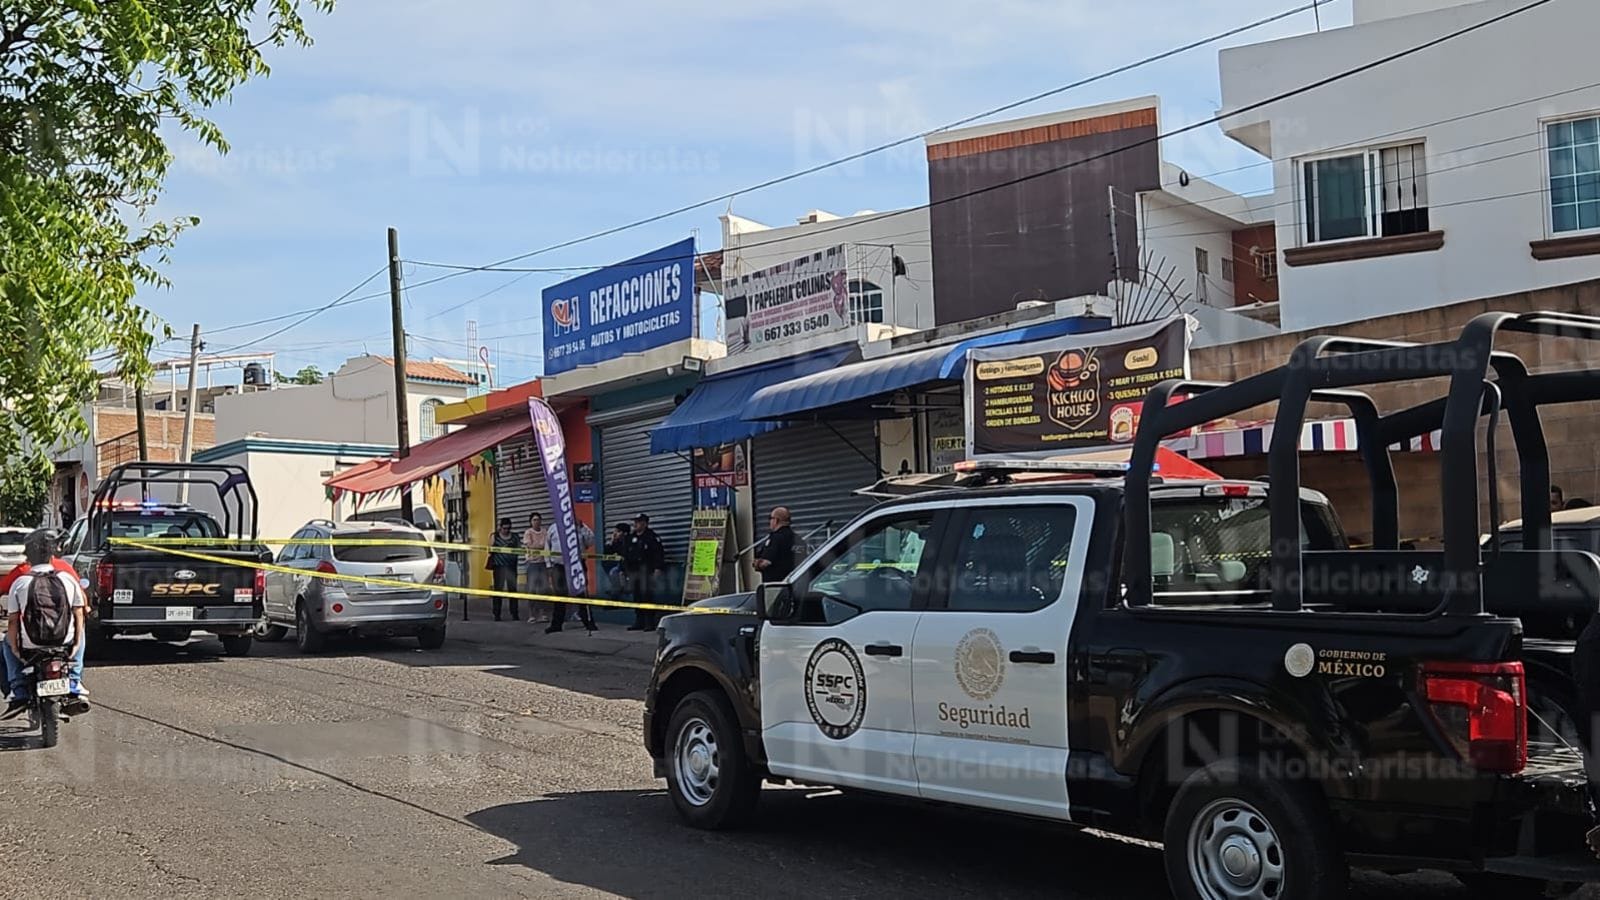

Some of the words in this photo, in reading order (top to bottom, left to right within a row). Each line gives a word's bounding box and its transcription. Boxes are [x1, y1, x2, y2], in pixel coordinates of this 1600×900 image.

[589, 263, 681, 326] REFACCIONES
[590, 332, 614, 348] AUTOS
[615, 328, 623, 341] Y
[623, 310, 680, 338] MOTOCICLETAS
[764, 327, 781, 342] 667
[783, 320, 802, 337] 333
[803, 313, 829, 334] 6540
[1115, 376, 1130, 387] MAR
[1115, 388, 1141, 399] QUESOS
[1056, 403, 1092, 419] HOUSE
[152, 583, 221, 595] SSPC
[1319, 649, 1371, 660] GOBIERNO
[1372, 652, 1386, 661] DE
[1318, 659, 1385, 678] MÉXICO
[816, 674, 853, 689] SSPC
[938, 702, 1031, 729] Seguridad
